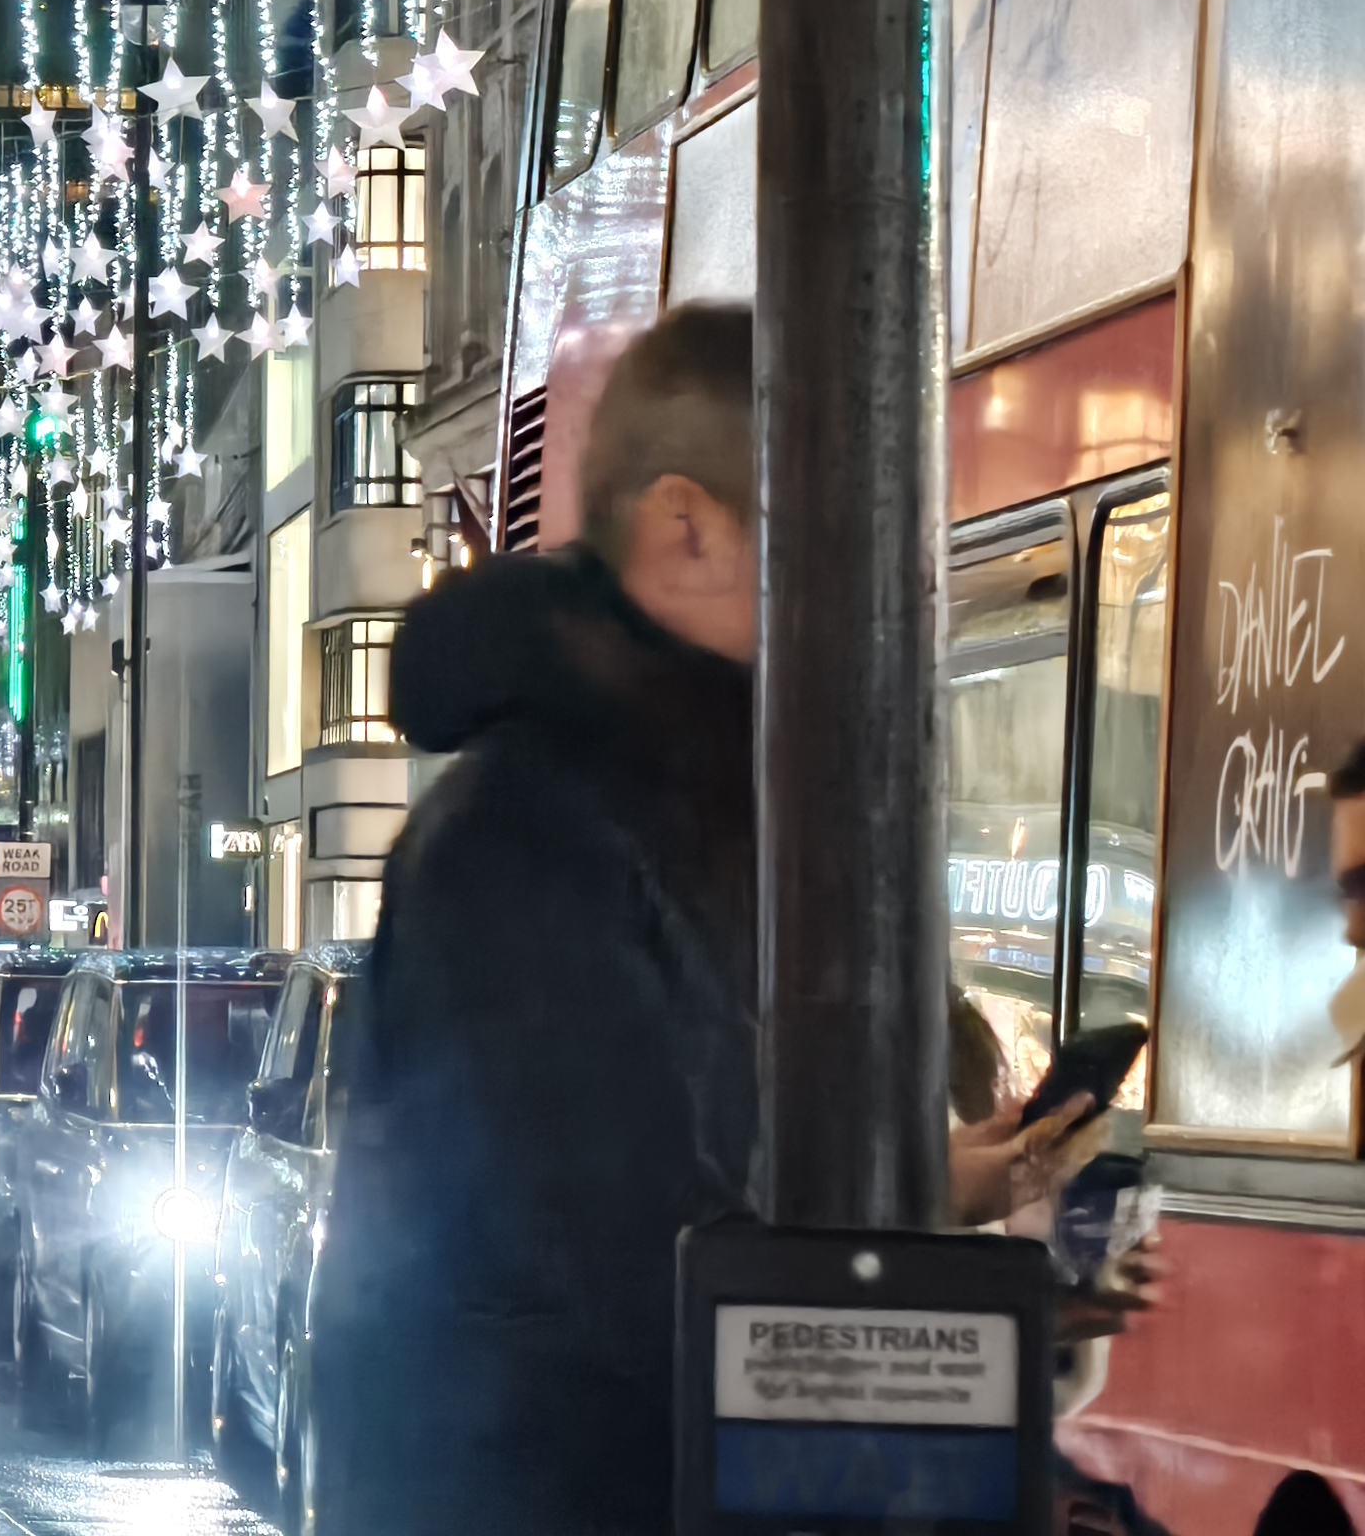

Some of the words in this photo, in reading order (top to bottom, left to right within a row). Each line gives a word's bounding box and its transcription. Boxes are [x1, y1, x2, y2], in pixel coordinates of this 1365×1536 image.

[1216, 514, 1346, 715] DANIEL
[1215, 716, 1327, 879] CRAIG
[2, 861, 40, 873] ROAD
[3, 849, 41, 859] WEAK
[749, 1321, 980, 1355] PEDESTRIANS
